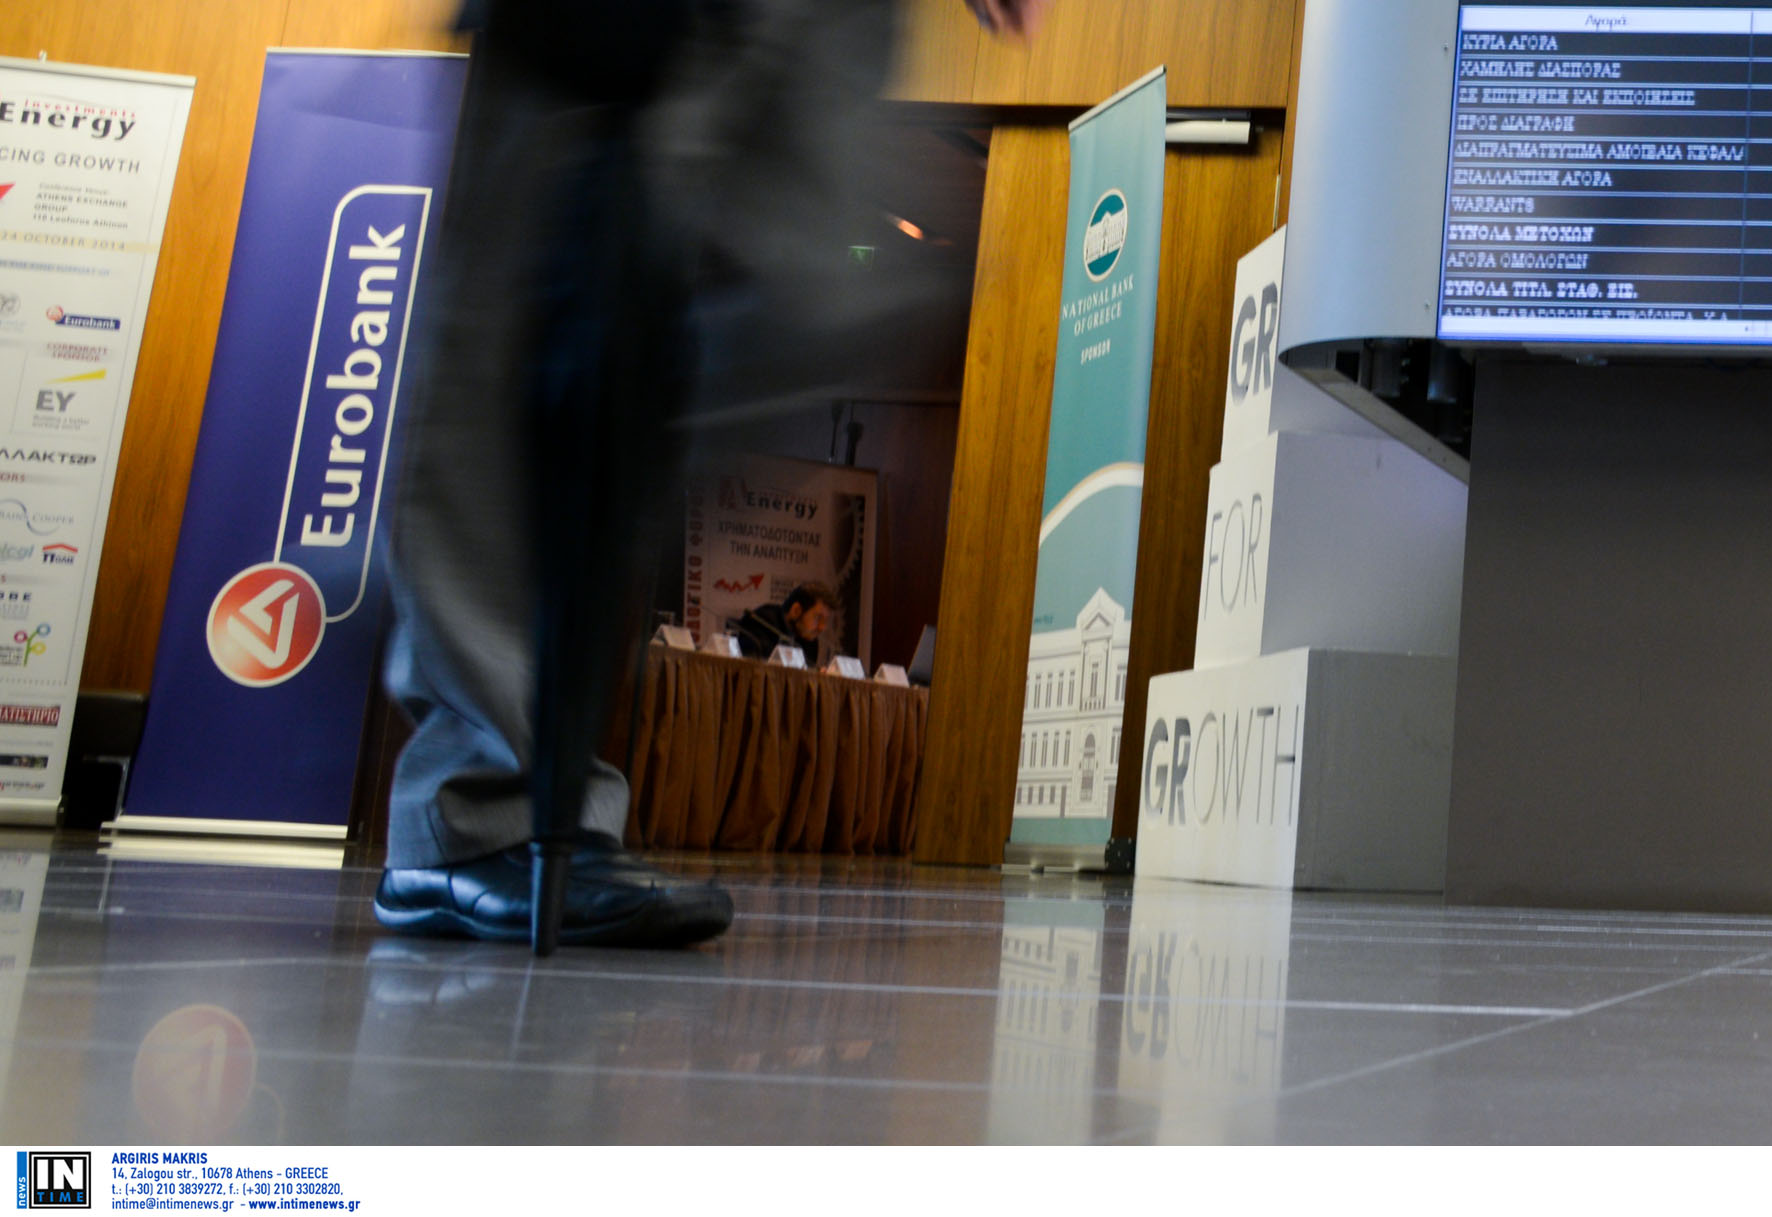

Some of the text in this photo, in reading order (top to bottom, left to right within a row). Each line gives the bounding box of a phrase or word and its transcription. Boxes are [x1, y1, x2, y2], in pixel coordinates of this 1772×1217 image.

[0, 101, 137, 141] Energy
[55, 152, 140, 174] GROWTH
[1451, 195, 1535, 213] WARRANTS
[1062, 274, 1134, 320] NATIONAL BANK
[1074, 300, 1122, 336] OF GREECE
[1081, 338, 1111, 365] SPONSOR
[35, 388, 76, 412] EY
[300, 223, 406, 548] Eurobank
[746, 490, 819, 520] Energy
[1203, 492, 1263, 622] FOR
[1145, 704, 1299, 825] GROWTH
